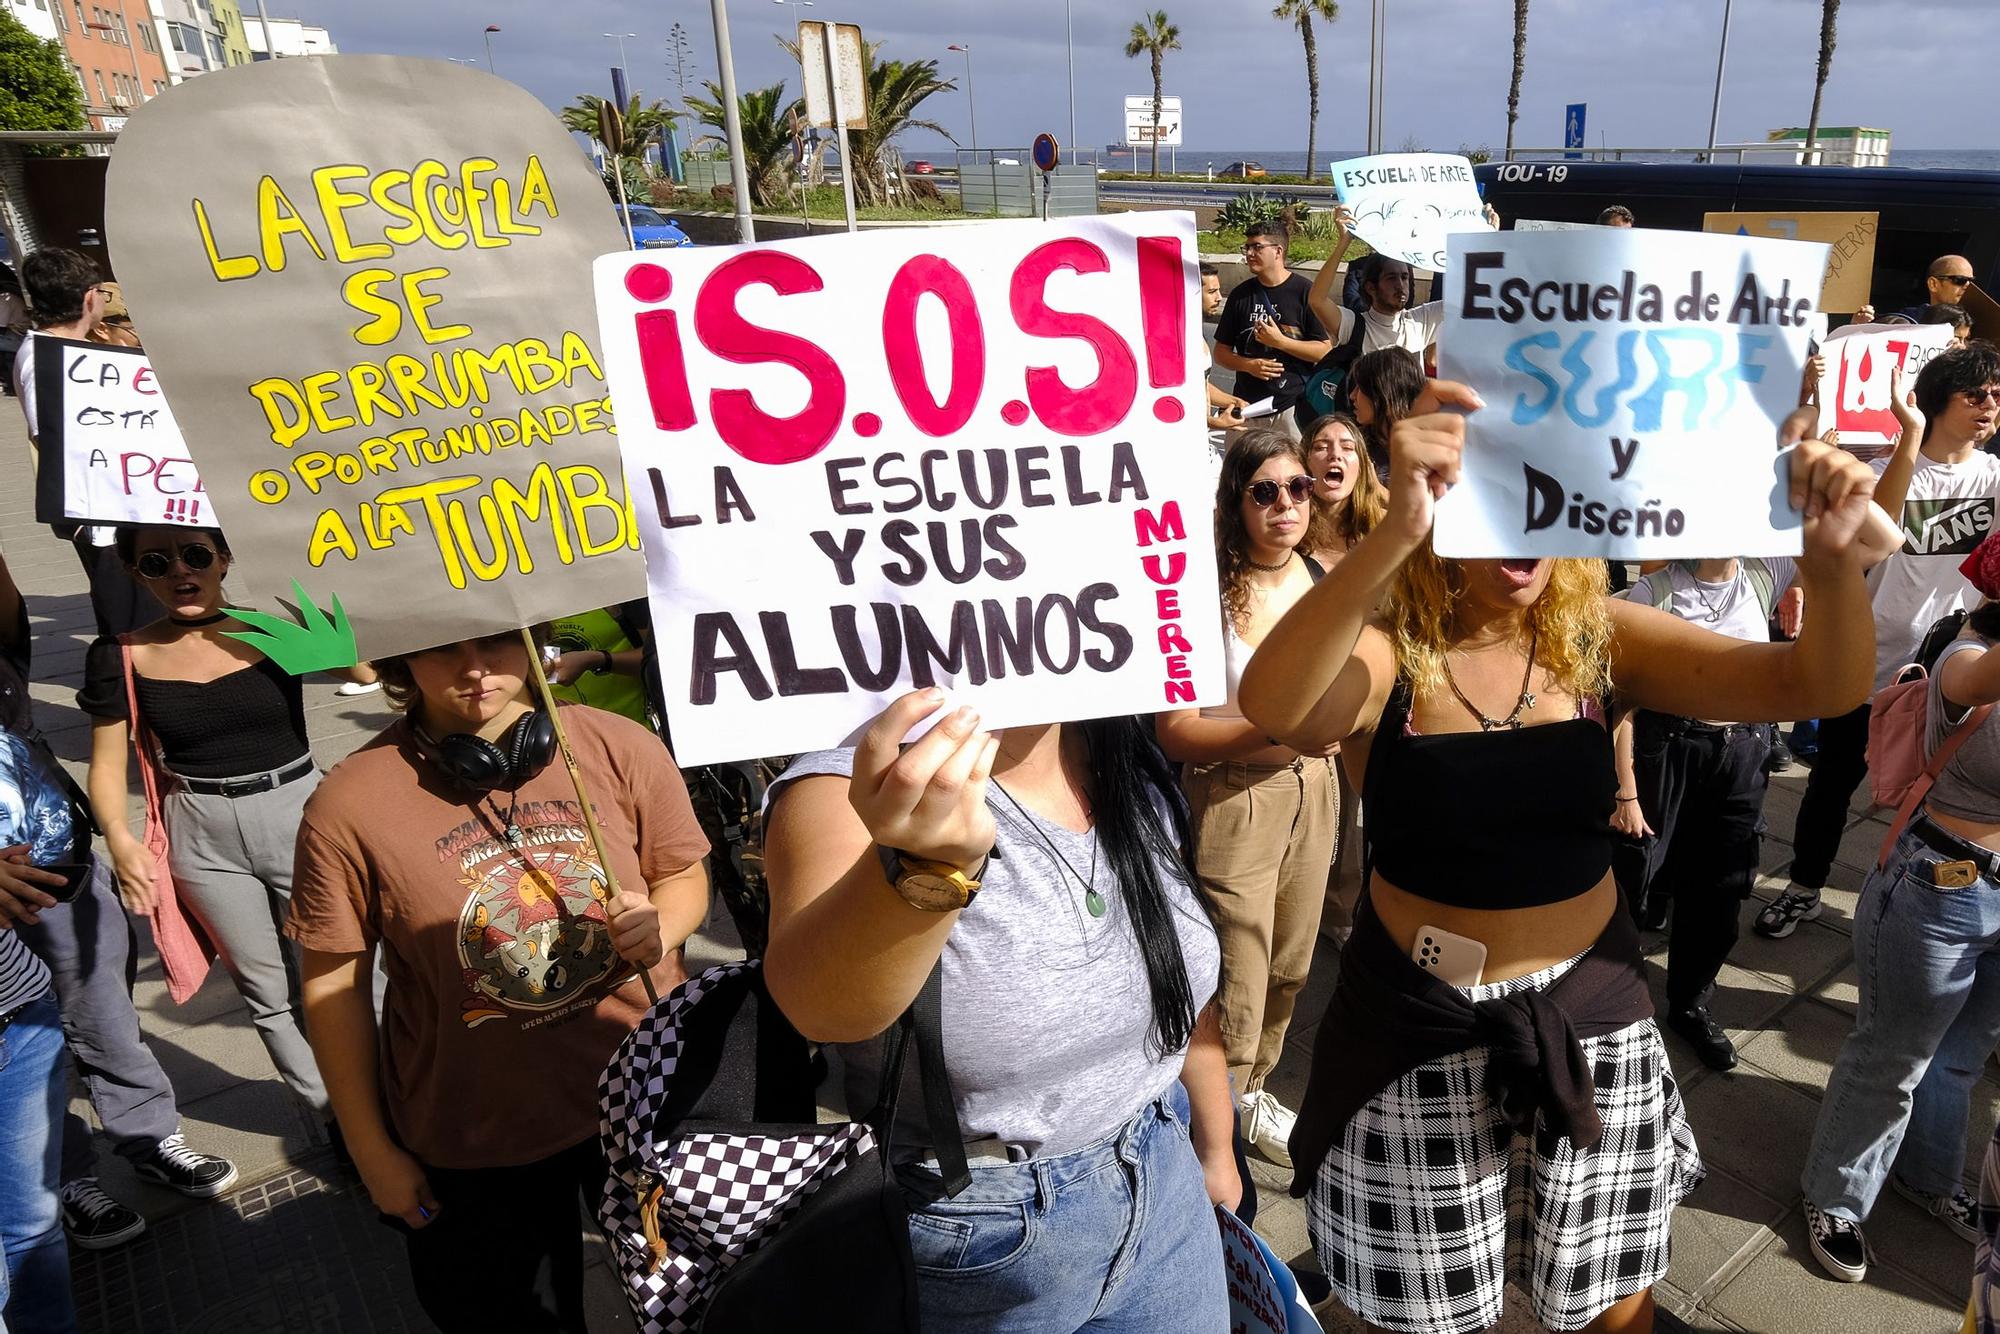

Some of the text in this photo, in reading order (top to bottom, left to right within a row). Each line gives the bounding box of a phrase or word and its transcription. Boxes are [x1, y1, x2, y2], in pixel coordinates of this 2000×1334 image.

[1343, 166, 1470, 188] ESCUELA DE ARTE
[193, 154, 558, 282] LA ESCUELA
[341, 267, 473, 346] SE
[1249, 313, 1281, 322] FLOD
[1254, 304, 1278, 312] PIK
[1460, 251, 1812, 328] Escuela de Arte
[68, 354, 120, 387] LA
[249, 330, 605, 449] DERRUMBA
[76, 406, 159, 430] ESTÁ
[89, 449, 108, 468] A
[647, 442, 1150, 529] LA ESCUELA
[308, 508, 358, 567] A
[359, 501, 416, 550] LA
[1522, 461, 1686, 538] Diseño
[1903, 500, 1993, 554] VANS
[809, 514, 1026, 587] Y SUS
[1134, 501, 1201, 705] MUEREN
[689, 582, 1134, 706] ALUMNOS
